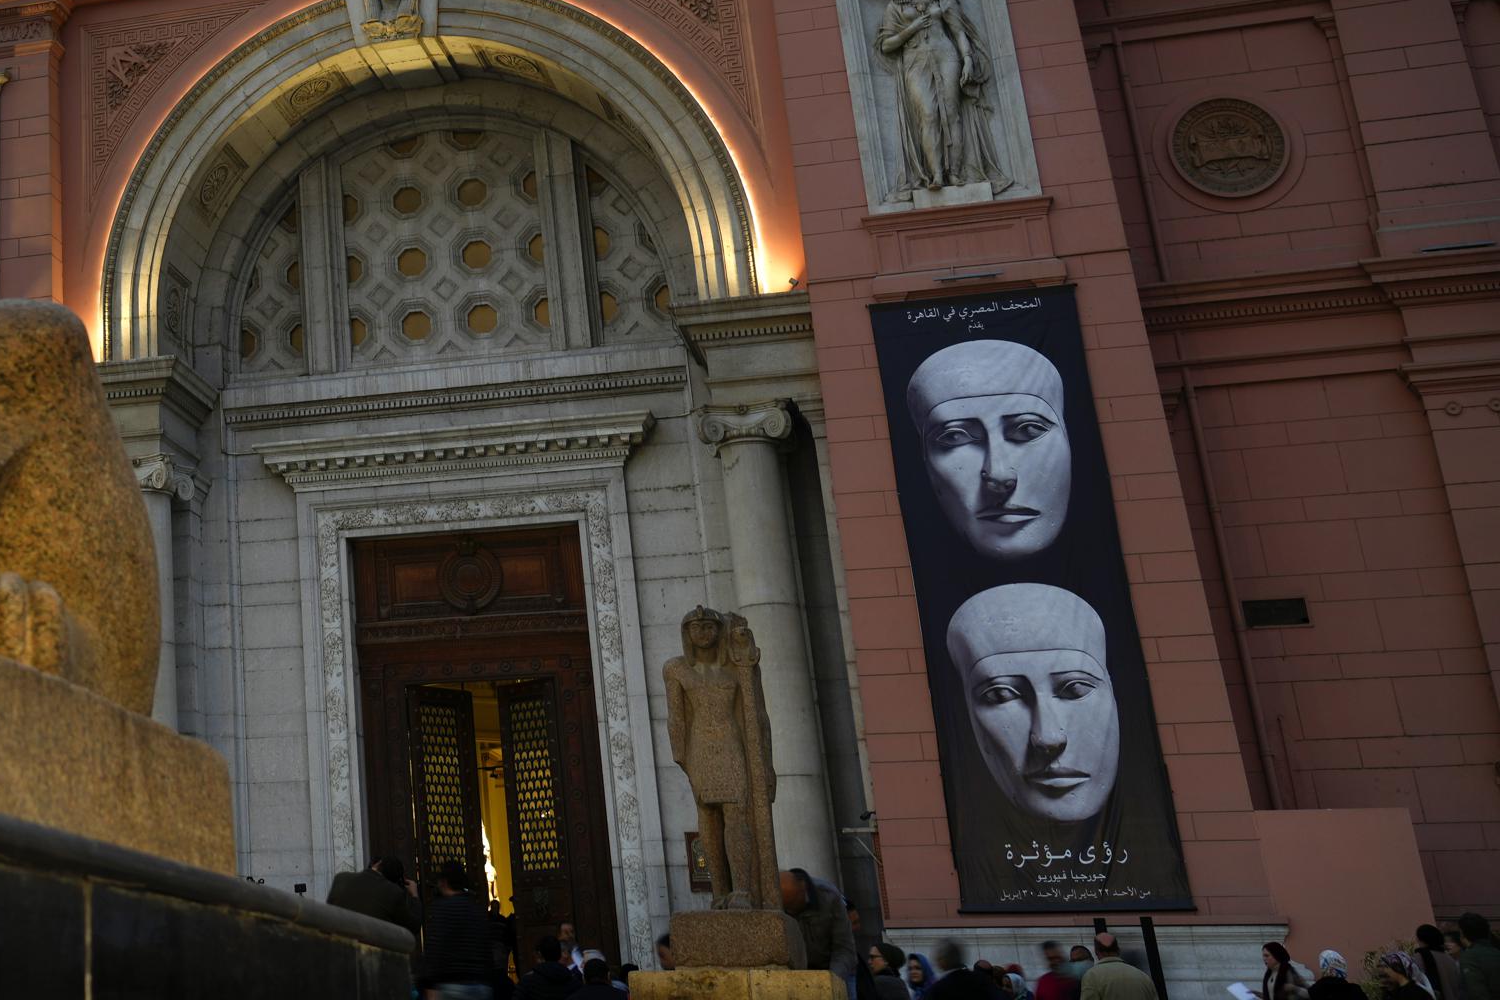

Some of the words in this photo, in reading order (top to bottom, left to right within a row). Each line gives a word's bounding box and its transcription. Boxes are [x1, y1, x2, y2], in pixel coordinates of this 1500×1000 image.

[958, 301, 999, 319] المصري
[1001, 297, 1042, 311] المتحف
[906, 308, 940, 323] القاهرة
[942, 306, 956, 322] في
[1004, 840, 1072, 868] مؤثرة
[1078, 841, 1128, 864] رؤى
[1035, 869, 1067, 882] فيوريو
[1070, 869, 1107, 882] جورجيا
[1078, 889, 1098, 900] يناير
[1139, 889, 1151, 900] من
